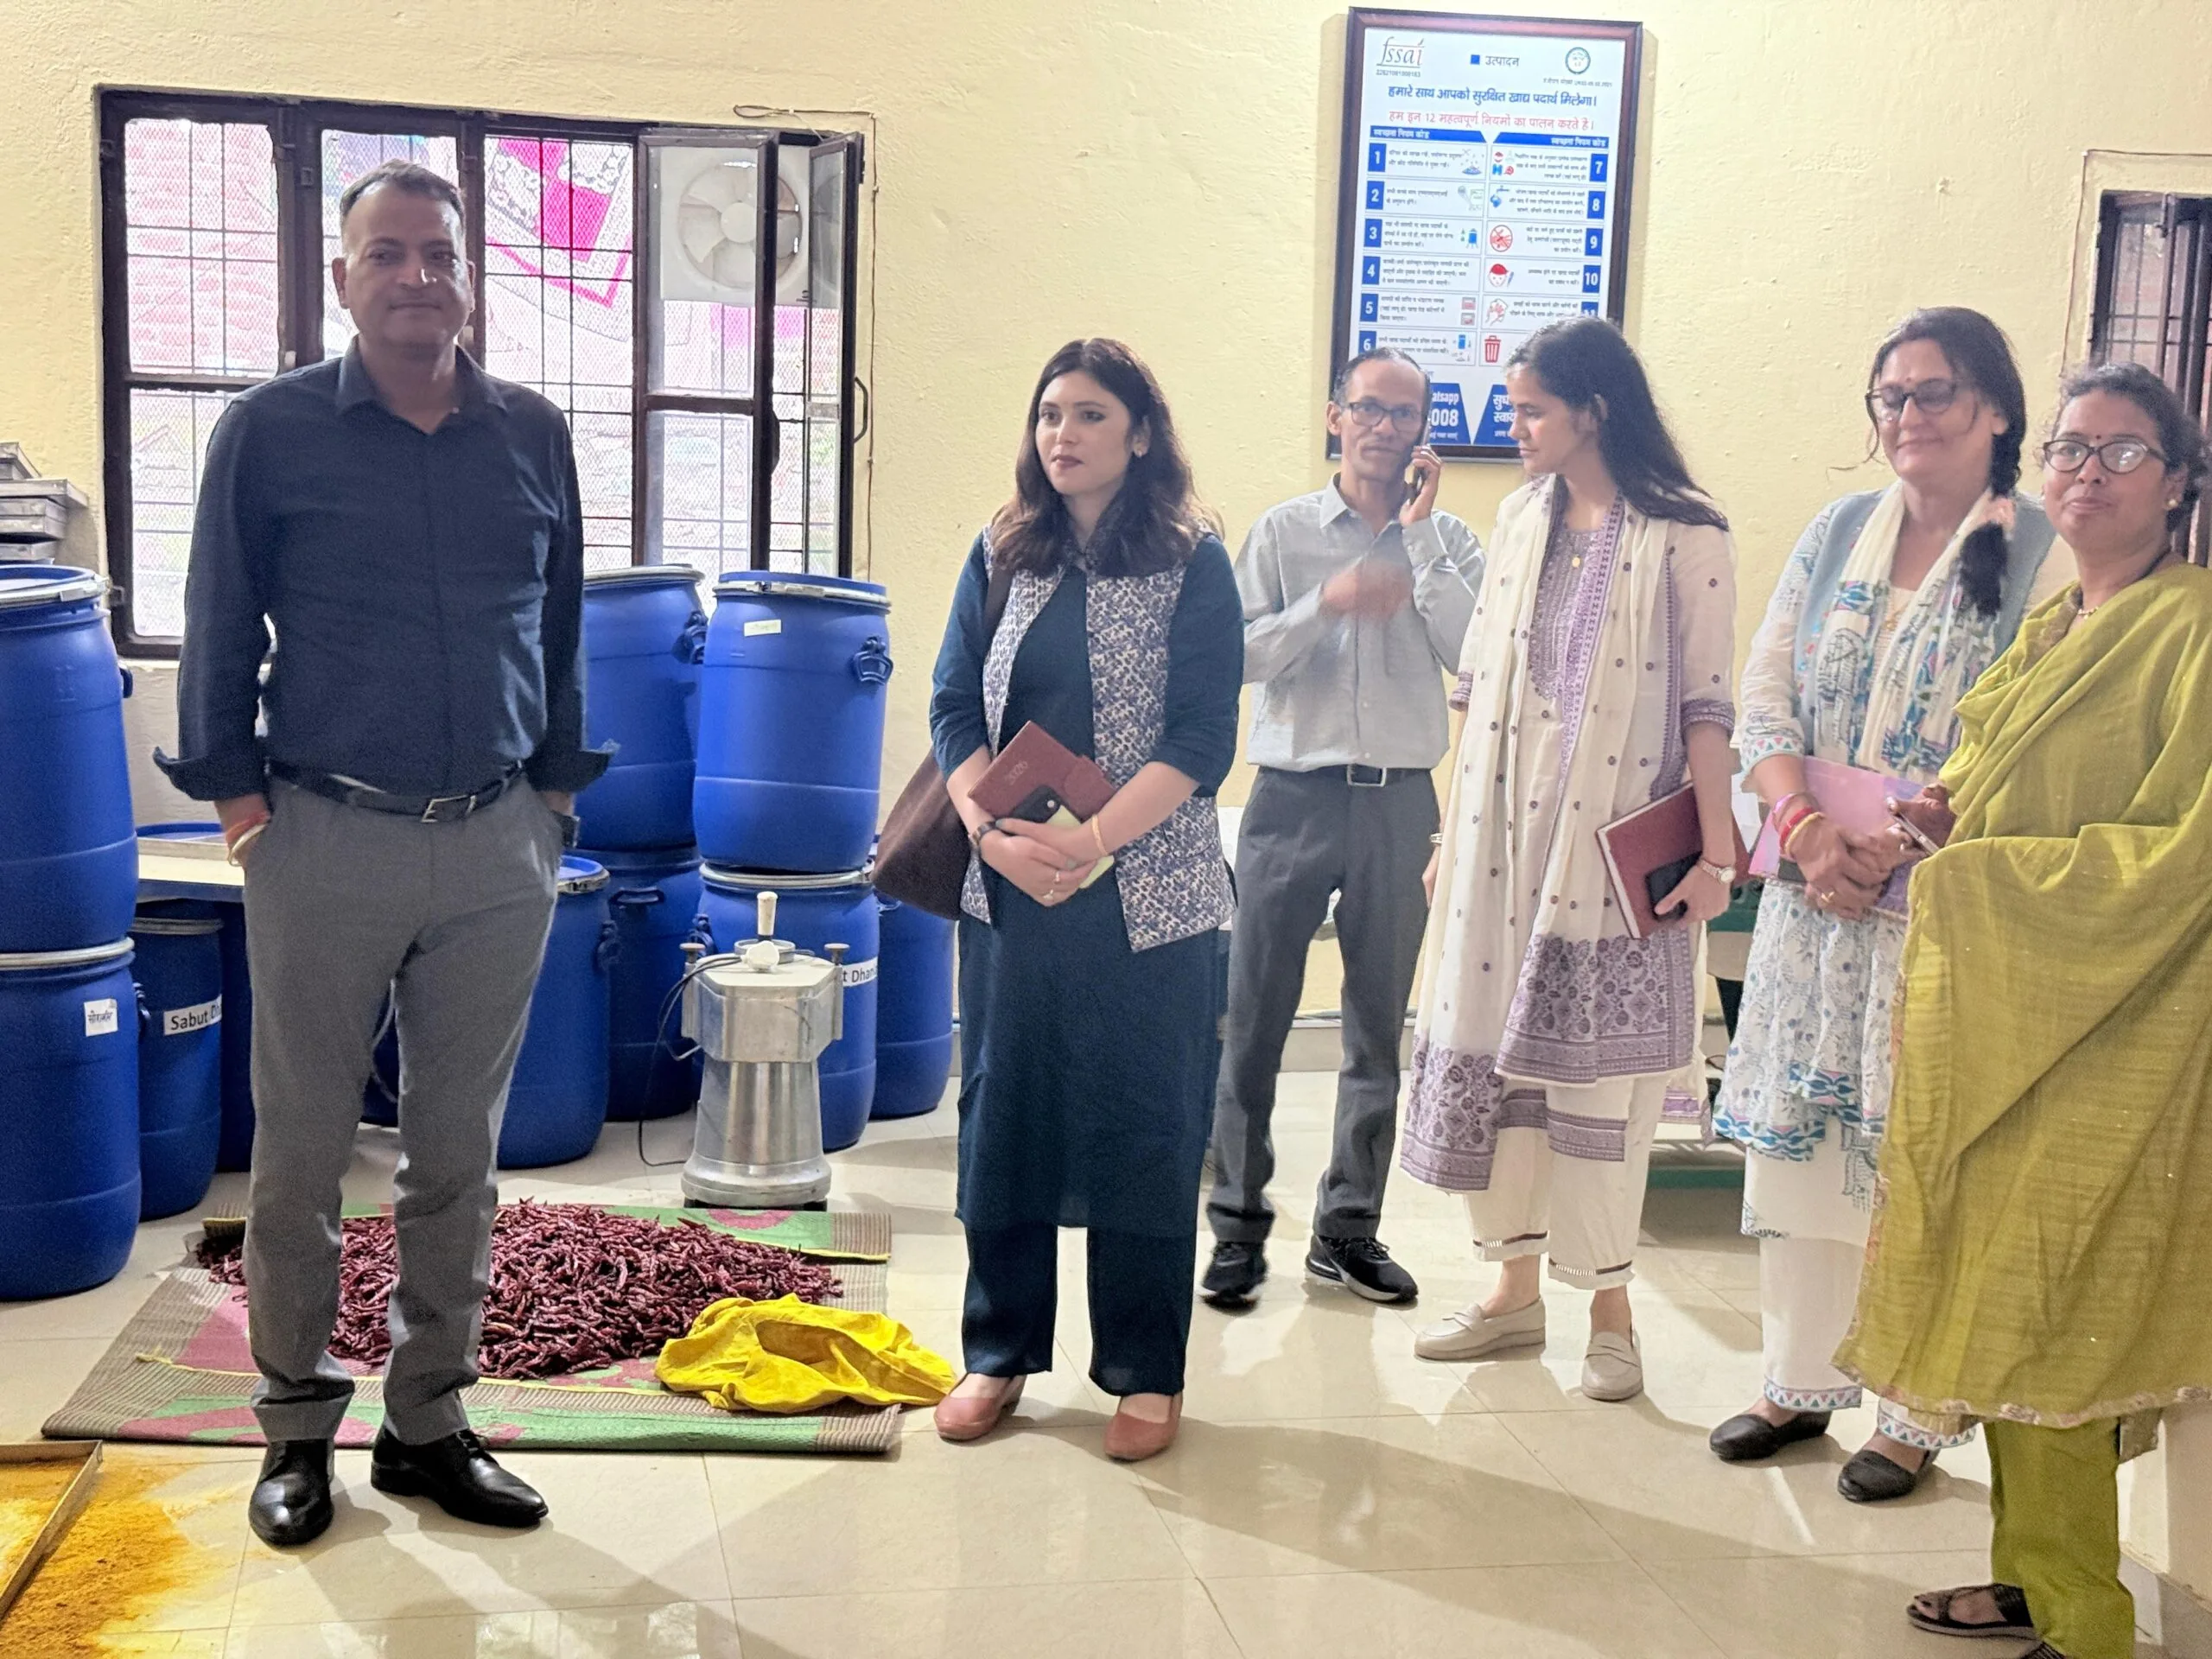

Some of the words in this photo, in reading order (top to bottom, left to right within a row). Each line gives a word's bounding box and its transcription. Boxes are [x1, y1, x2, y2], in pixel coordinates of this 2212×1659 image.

[1485, 55, 1519, 67] उत्पादन
[1388, 84, 1413, 97] हमारे
[1415, 87, 1434, 98] साथ
[1437, 86, 1470, 100] आपको
[1472, 87, 1505, 105] सुरक्षित
[1389, 111, 1404, 121] हम
[1408, 112, 1421, 123] इन
[1426, 113, 1435, 123] 12
[1514, 118, 1526, 126] का
[1529, 118, 1554, 129] पालन
[1375, 150, 1381, 164] 1
[1594, 161, 1603, 175] 7
[1371, 188, 1380, 202] 2
[1592, 198, 1600, 212] 8
[1369, 226, 1377, 239] 3
[1589, 235, 1598, 249] 9
[1367, 264, 1376, 277] 4
[1585, 273, 1599, 286] 10
[1365, 301, 1374, 315] 5
[1363, 338, 1371, 351] 6
[1431, 409, 1459, 427] 008
[852, 967, 876, 982] Dhan
[171, 1009, 207, 1030] Sabut
